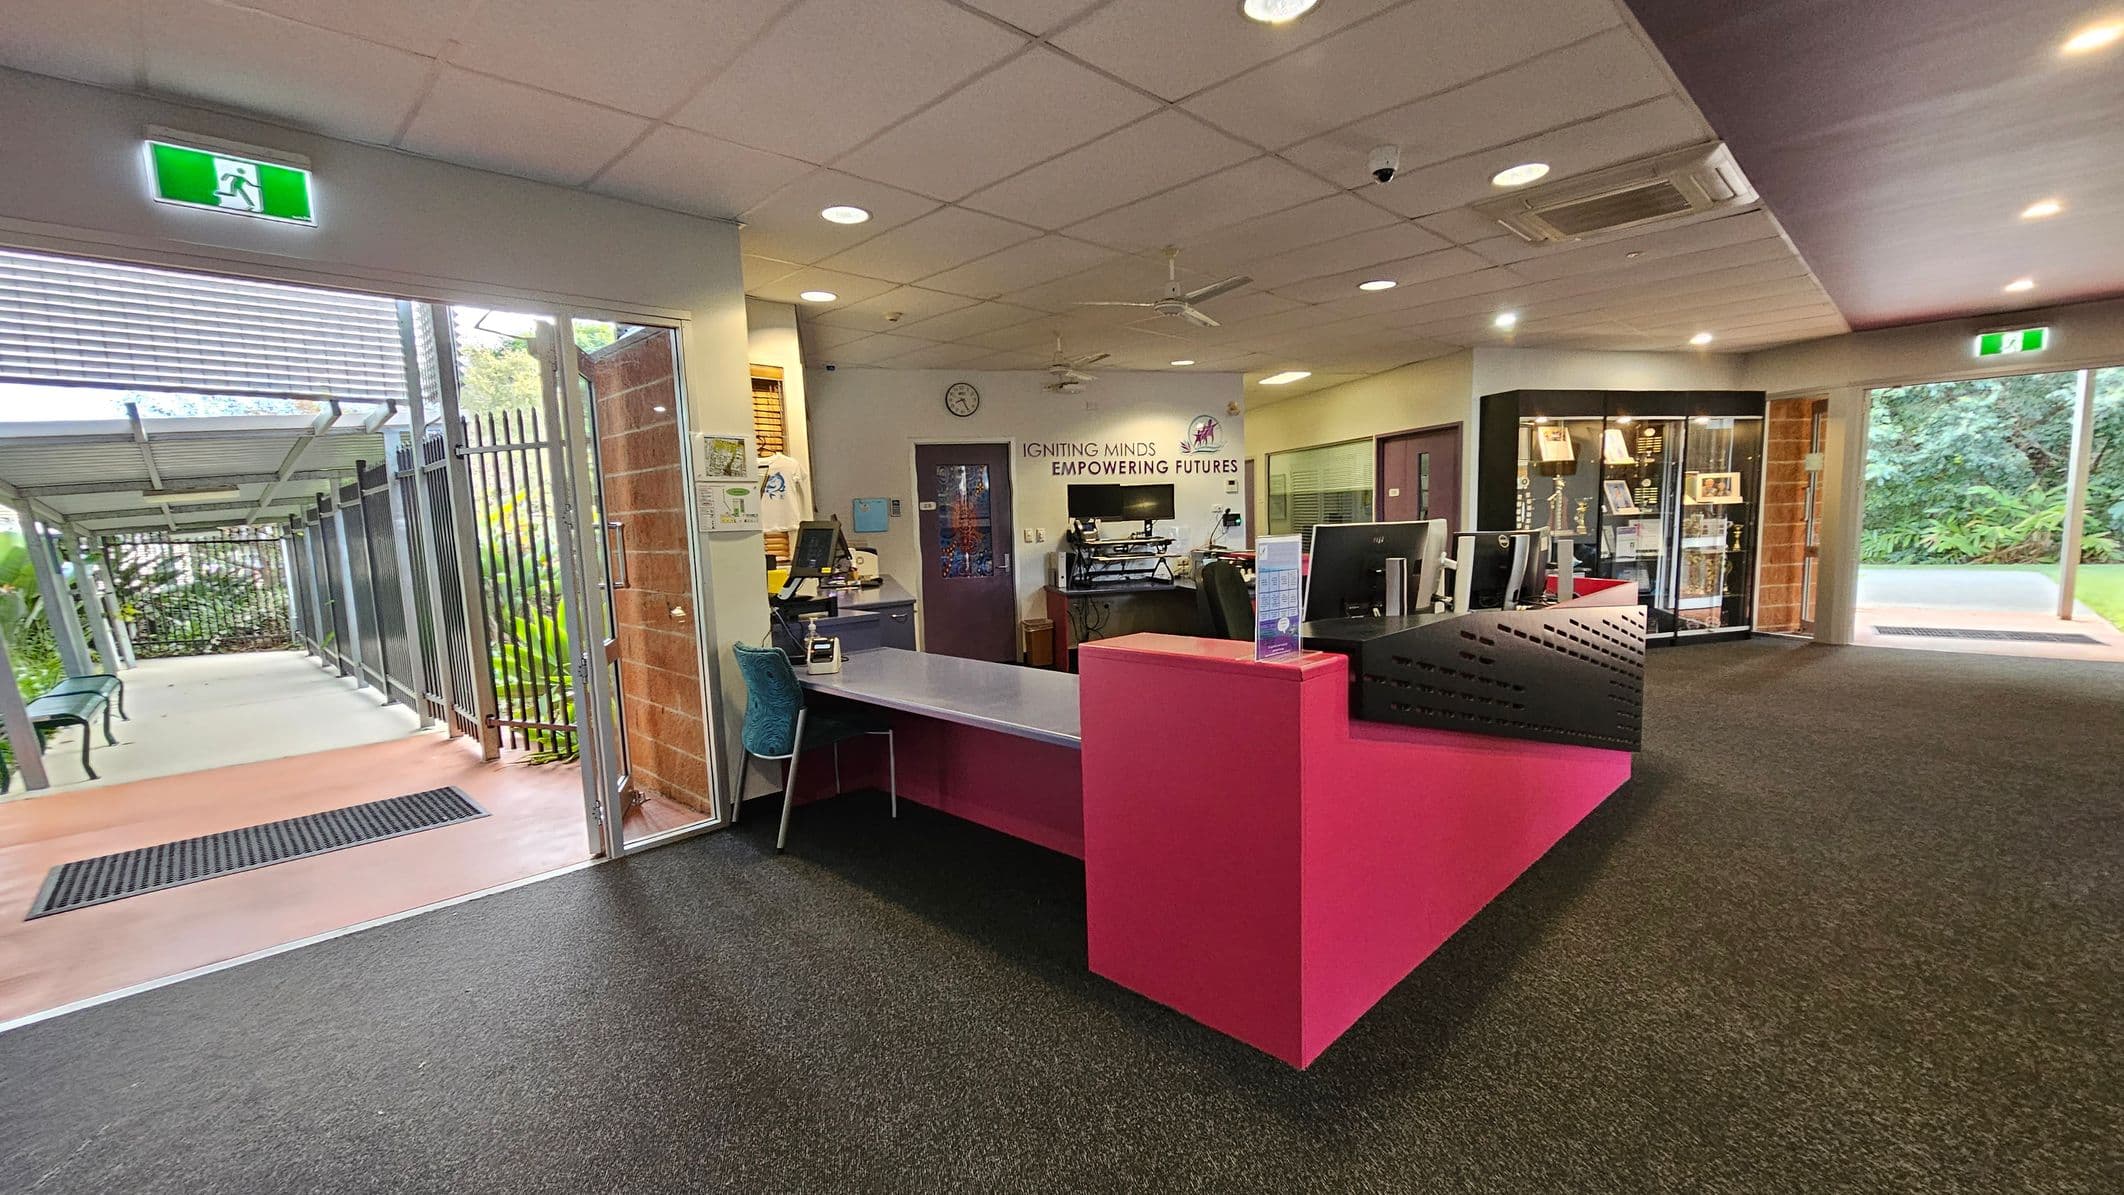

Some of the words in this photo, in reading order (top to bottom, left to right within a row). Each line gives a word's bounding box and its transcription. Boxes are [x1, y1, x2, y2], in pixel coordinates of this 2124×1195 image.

[1023, 442, 1098, 457] IGNITING
[1104, 442, 1156, 457] MINDS
[1052, 460, 1169, 475] EMPOWERING
[1175, 459, 1238, 474] FUTURES
